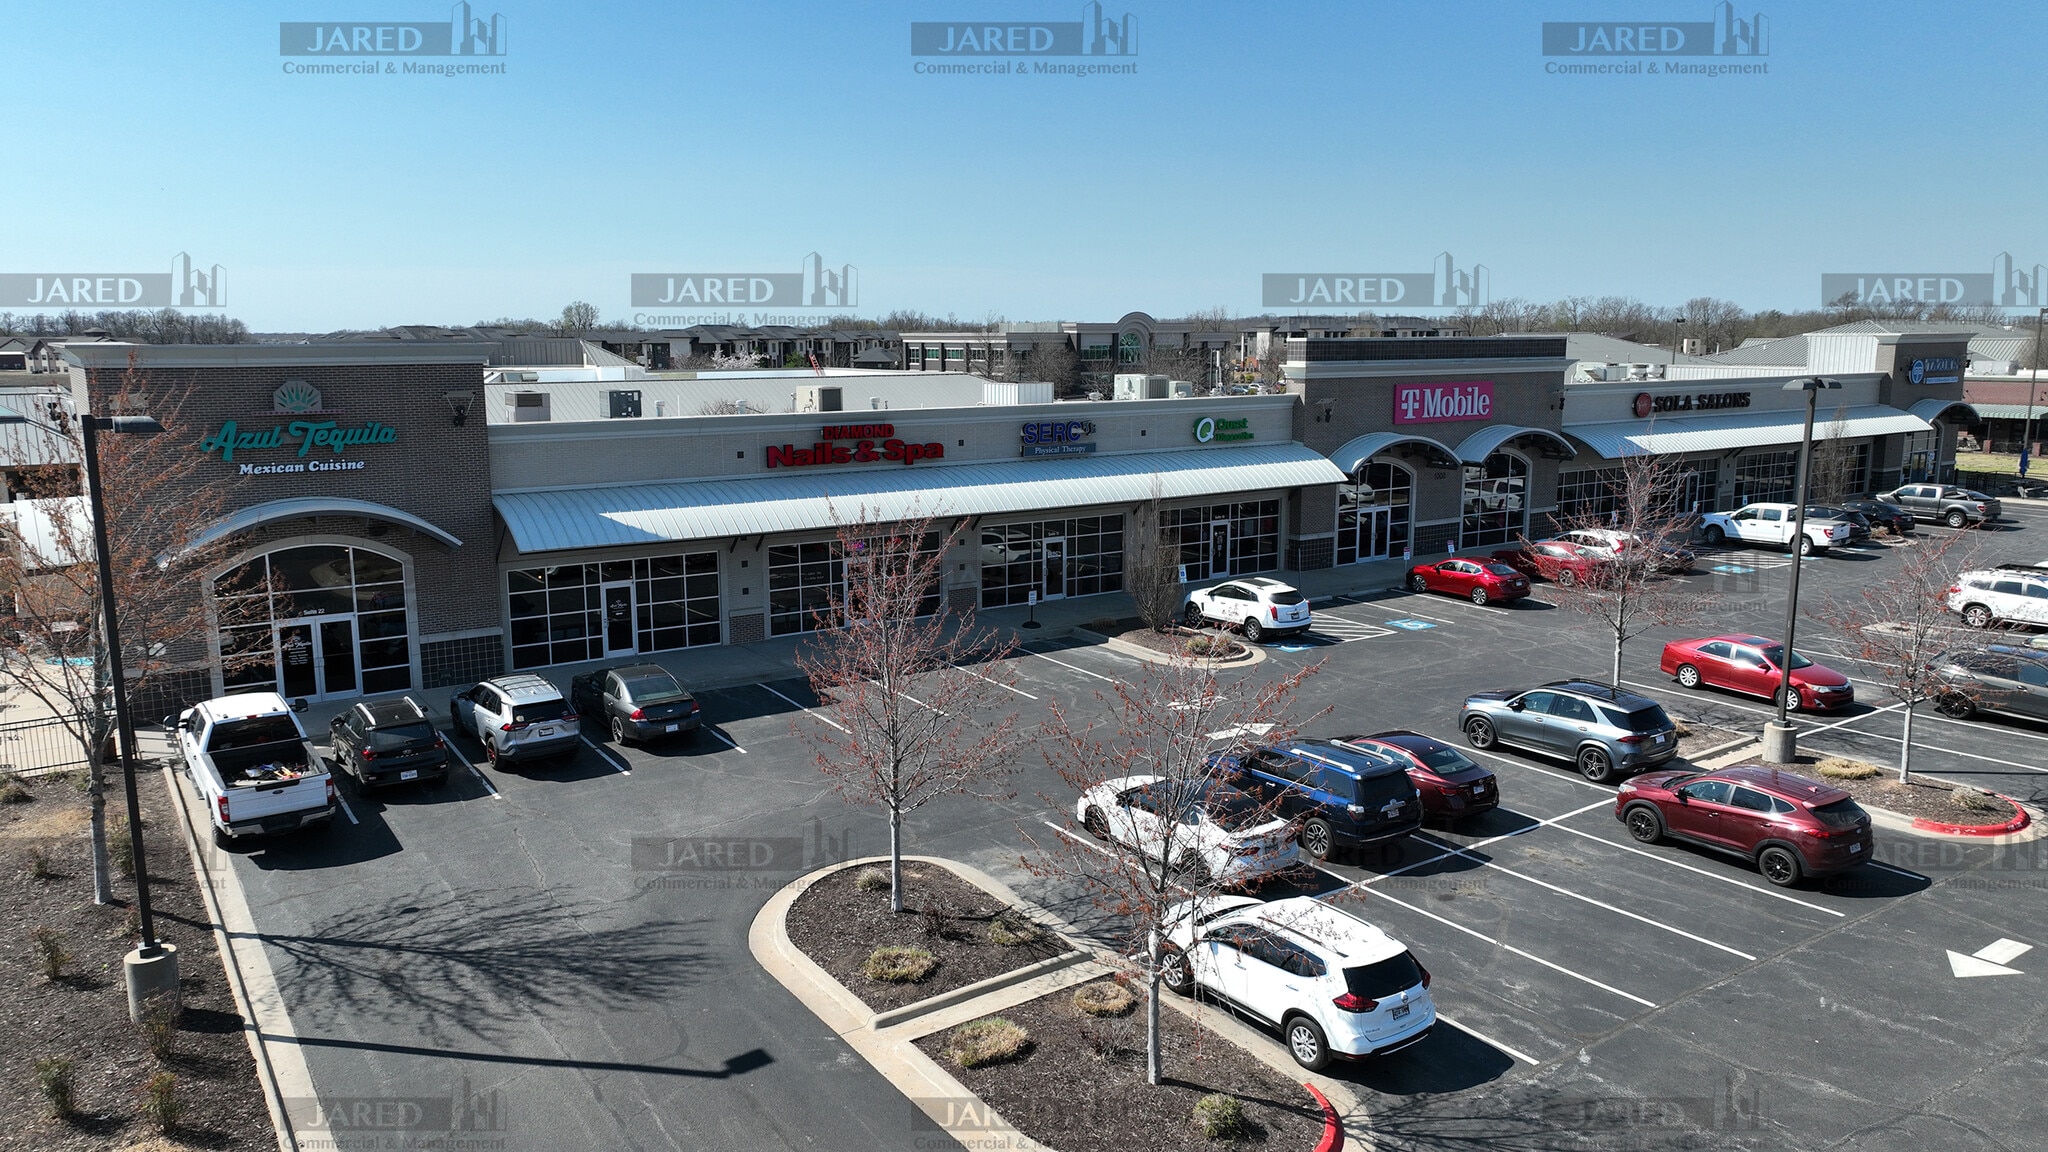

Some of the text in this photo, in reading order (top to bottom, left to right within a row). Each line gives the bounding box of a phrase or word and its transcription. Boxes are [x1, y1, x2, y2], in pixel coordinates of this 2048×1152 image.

[1422, 387, 1490, 418] Mobile
[1653, 395, 1693, 412] SOLA
[1696, 392, 1751, 410] SALONS
[823, 424, 895, 440] DIAMOND
[1023, 421, 1082, 445] SERC
[1216, 418, 1249, 430] Quest
[200, 420, 398, 462] Azul Tequila
[1034, 445, 1086, 455] Physical Therapy
[767, 439, 944, 468] Nails & Spa
[239, 459, 365, 475] Mexican Cuisine
